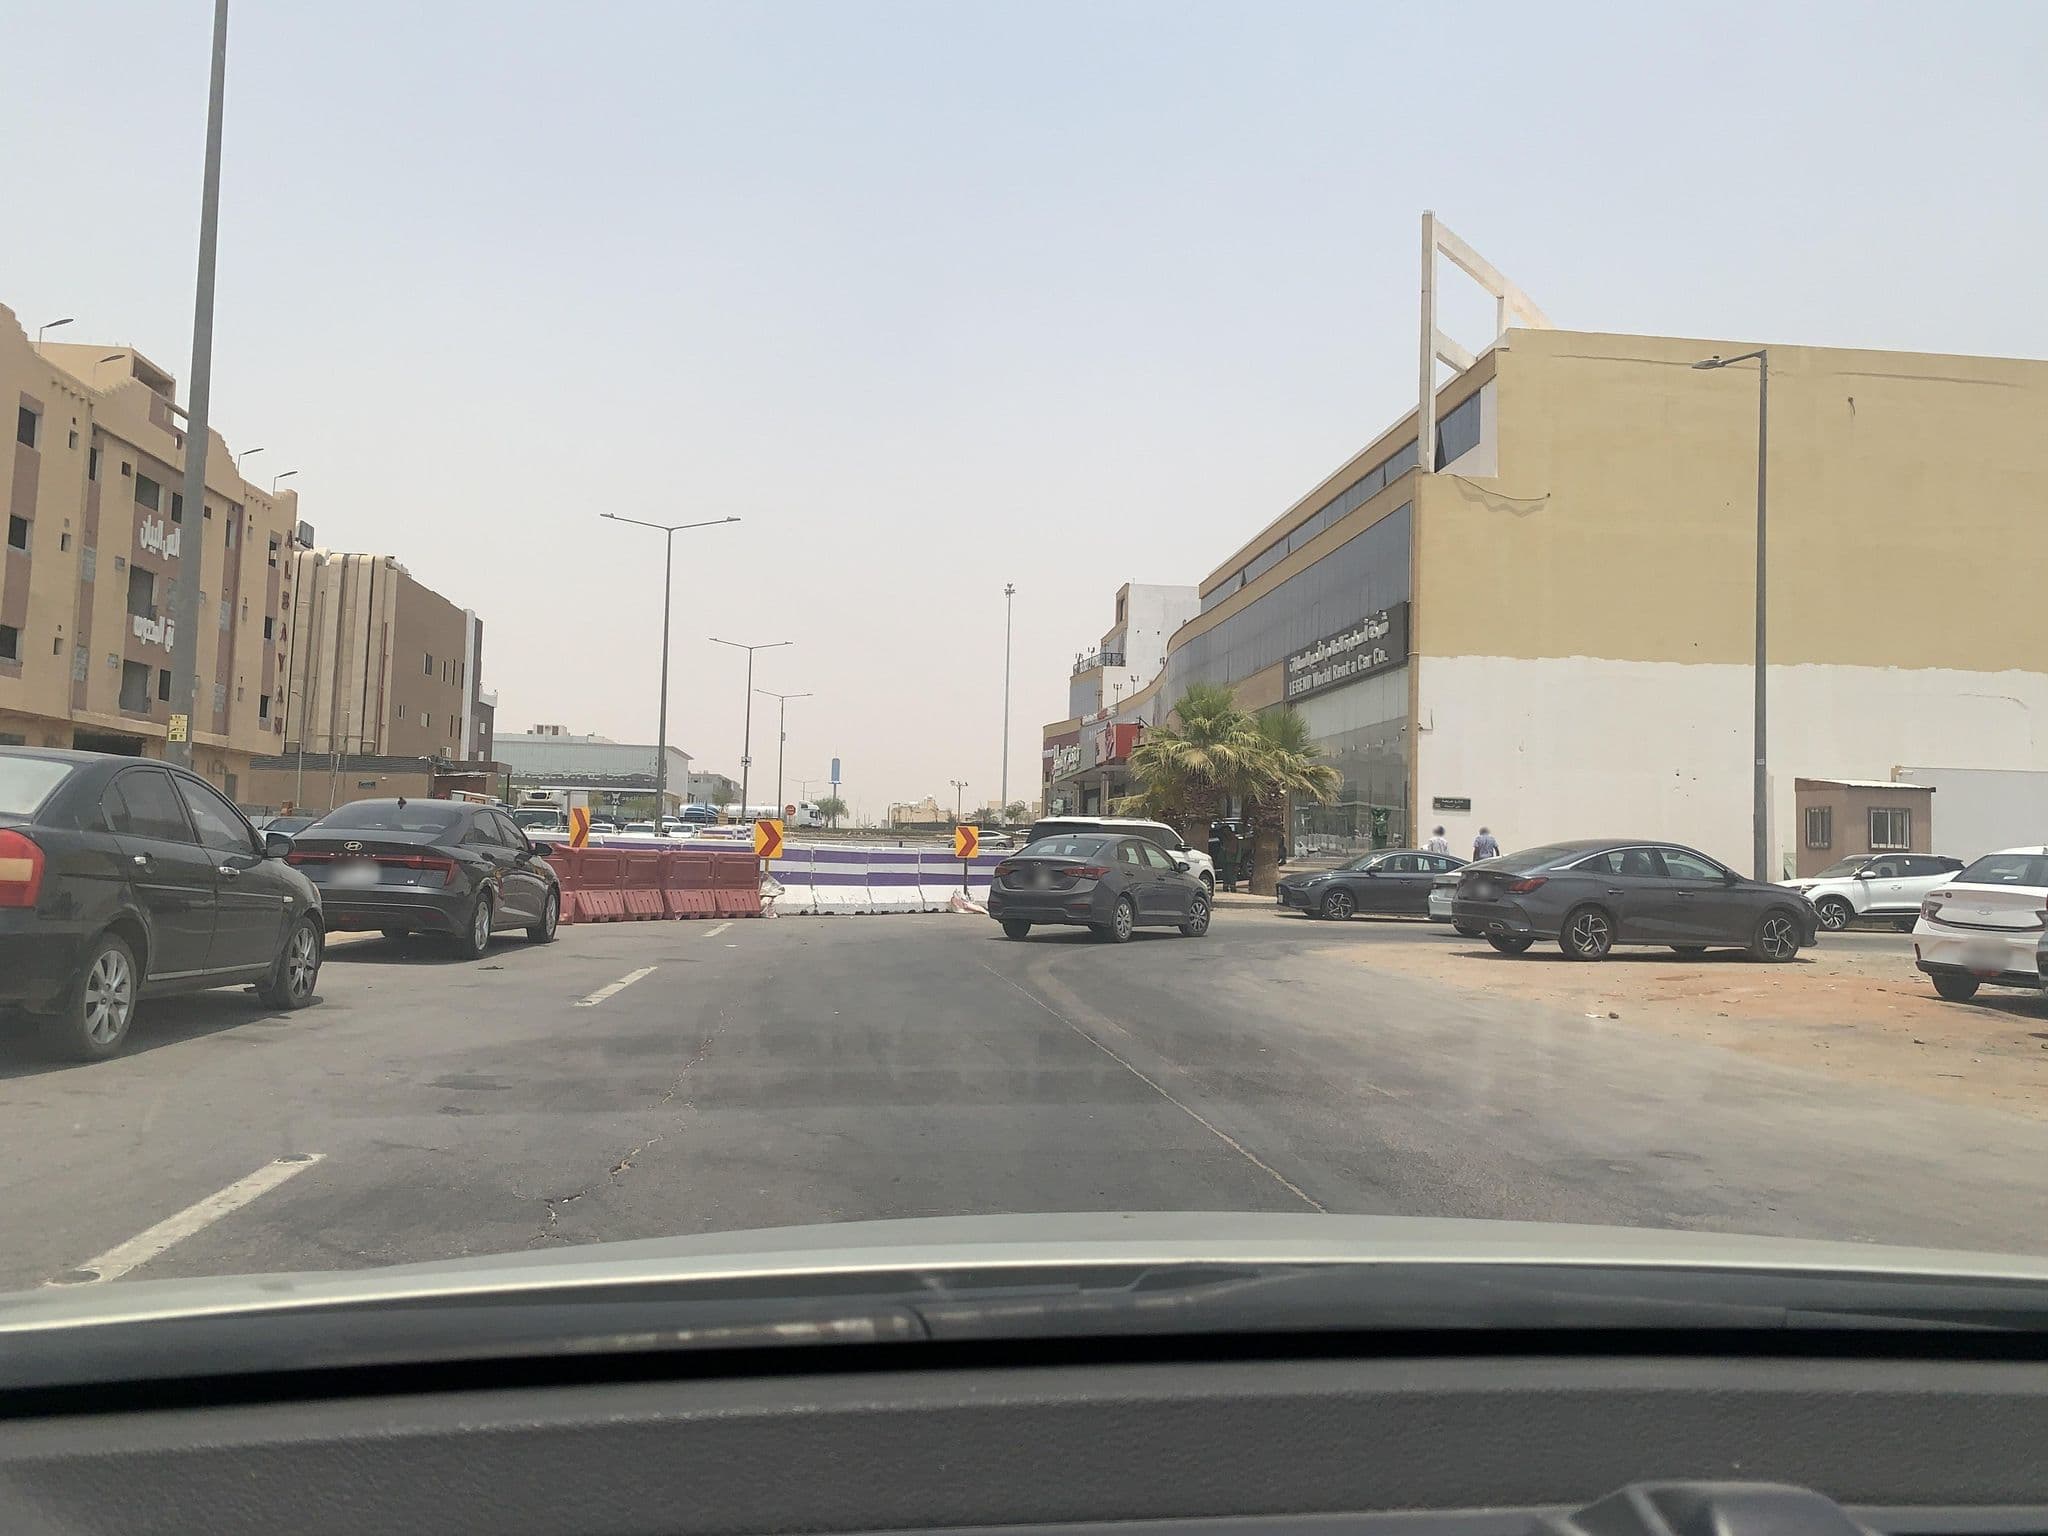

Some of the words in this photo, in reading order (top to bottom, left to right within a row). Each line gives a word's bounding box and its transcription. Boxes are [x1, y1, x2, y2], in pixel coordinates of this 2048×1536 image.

[1289, 674, 1312, 696] LEGEND
[1312, 666, 1332, 688] World
[1332, 660, 1351, 681] Rent
[1358, 654, 1372, 671] Car
